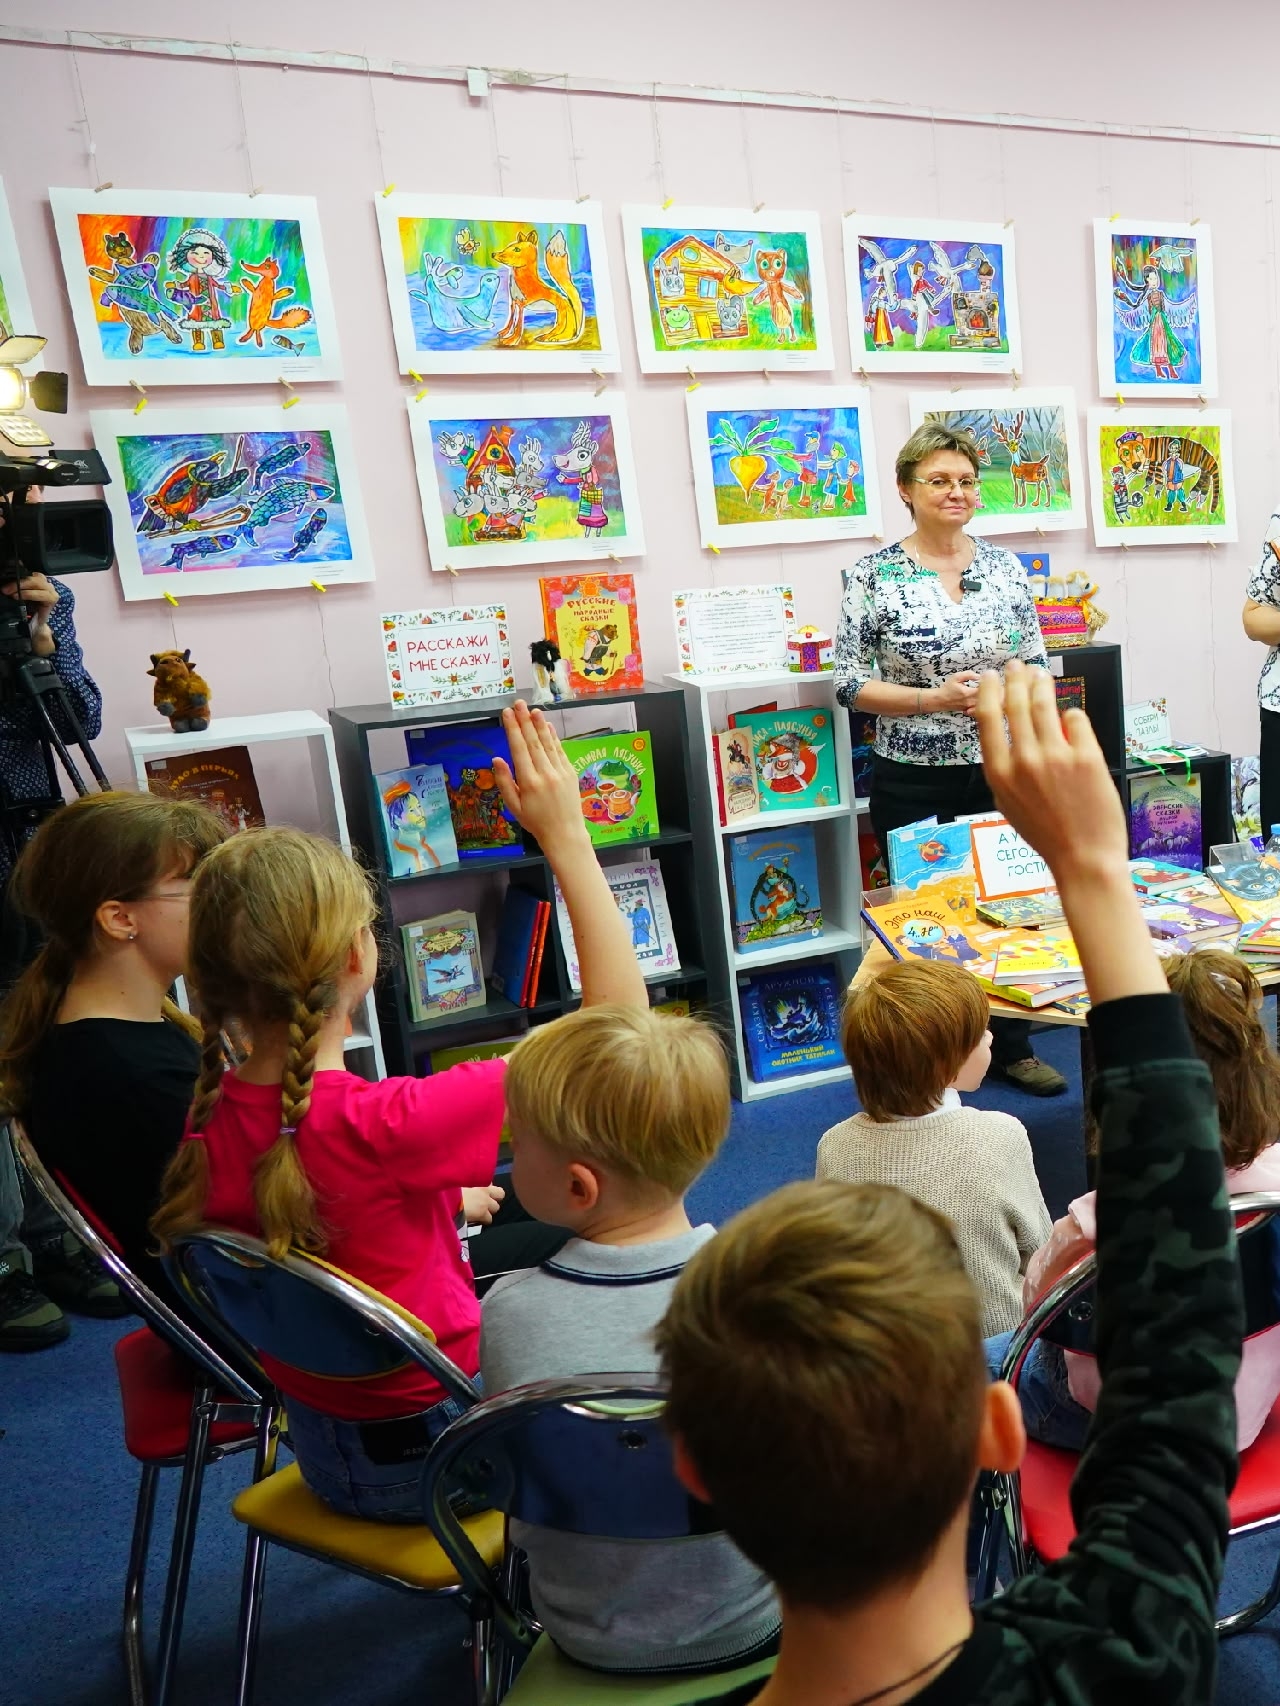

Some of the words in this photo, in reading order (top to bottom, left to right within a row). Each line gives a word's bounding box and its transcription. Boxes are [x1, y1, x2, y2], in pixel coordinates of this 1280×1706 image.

[567, 597, 617, 609] РУССКИЕ
[573, 608, 614, 616] НАРОДНЫЕ
[406, 635, 489, 654] РАССКАЖИ
[409, 658, 438, 673] МНЕ
[1133, 713, 1159, 727] СОБЕРИ
[575, 747, 607, 774] СТЛИВАЯ
[613, 746, 647, 776] ЛЯГУШКА
[1155, 809, 1180, 817] СКАЗКИ
[998, 833, 1010, 845] А
[884, 912, 911, 929] Это
[914, 909, 946, 922] наш
[751, 1002, 766, 1043] СКАЗКИ
[781, 1044, 824, 1059] МАЛЕНЬКИЙ
